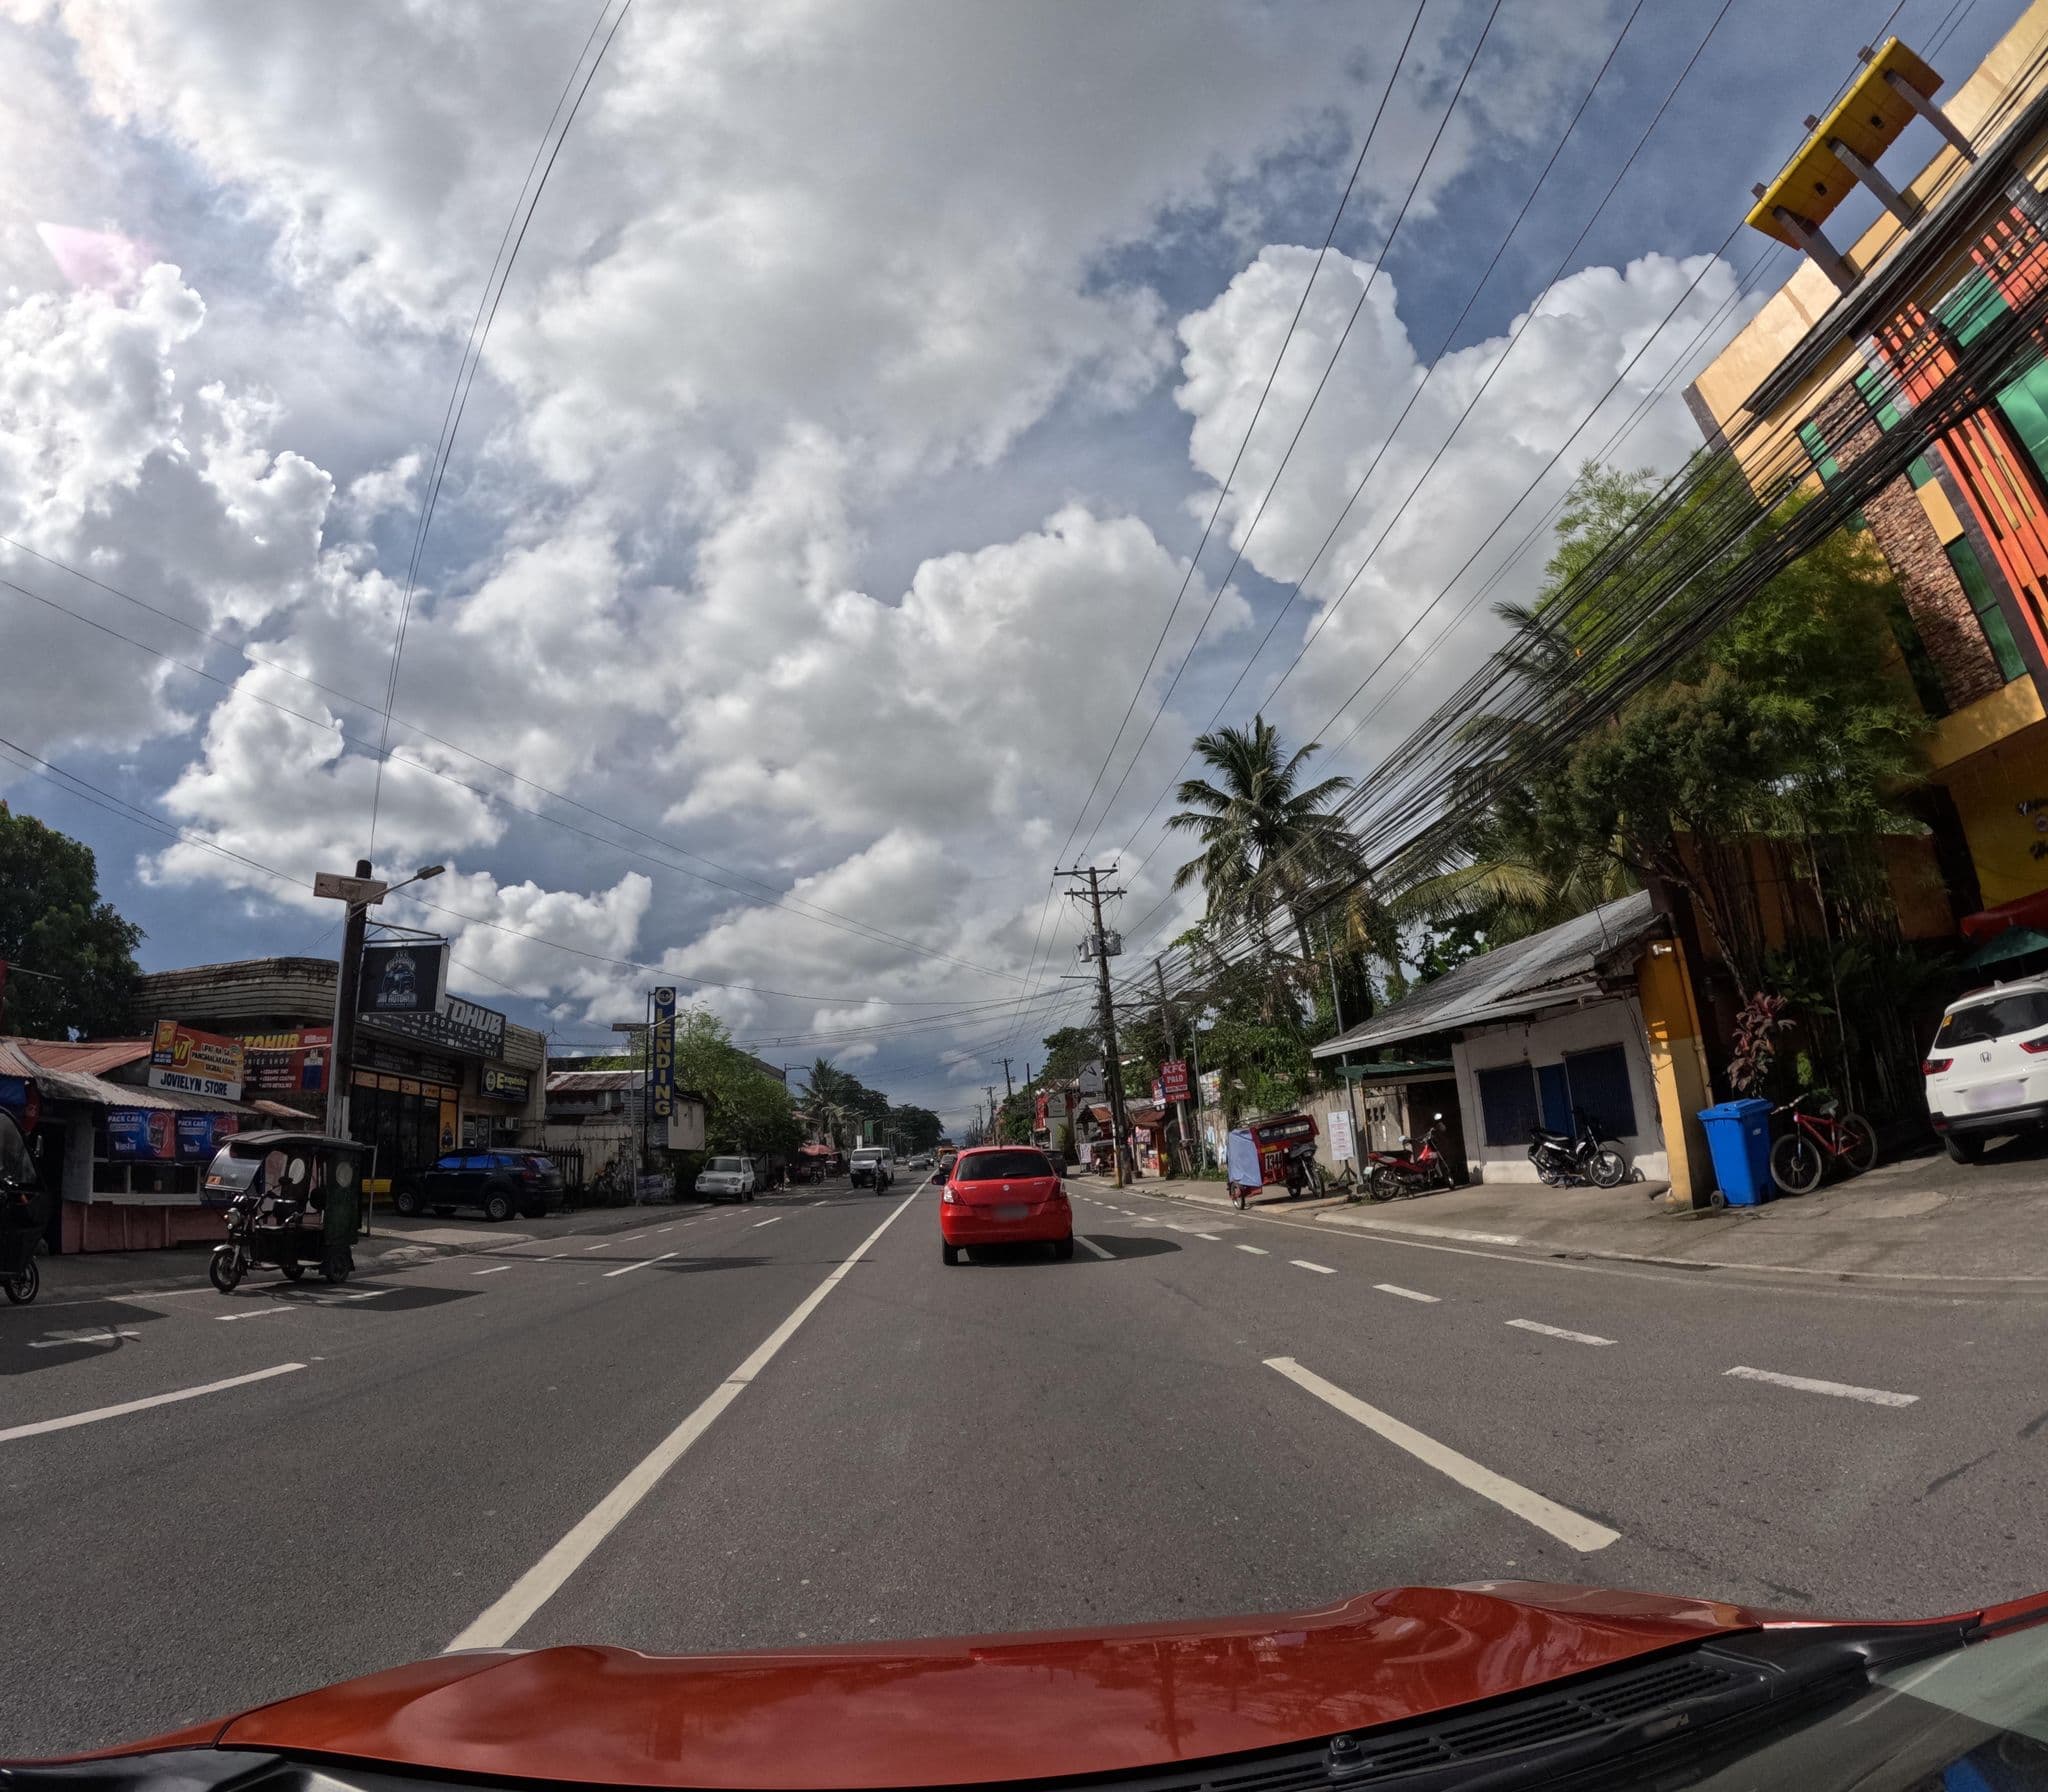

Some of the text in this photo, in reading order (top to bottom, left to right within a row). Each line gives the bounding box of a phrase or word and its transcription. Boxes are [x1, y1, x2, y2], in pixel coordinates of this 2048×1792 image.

[655, 1008, 672, 1116] LENDING
[1162, 1063, 1186, 1075] KFC
[160, 1072, 228, 1096] JOVIELYN STORE
